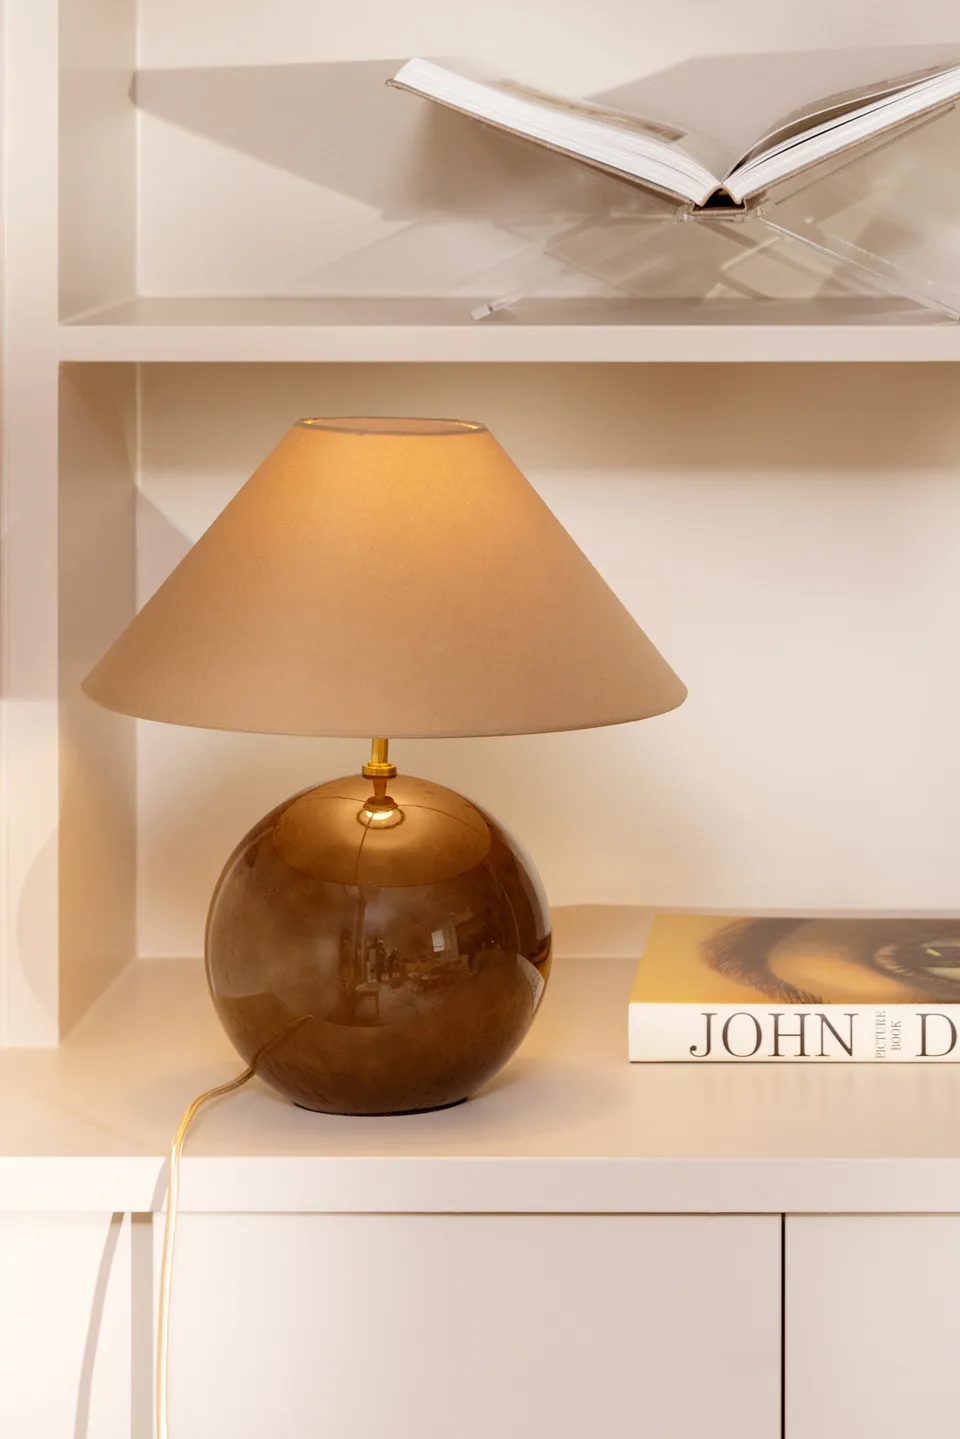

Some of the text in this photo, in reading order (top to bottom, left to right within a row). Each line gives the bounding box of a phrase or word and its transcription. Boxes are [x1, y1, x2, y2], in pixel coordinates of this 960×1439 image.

[690, 1012, 858, 1057] JOHN
[875, 1010, 886, 1058] PICTURE
[891, 1020, 902, 1051] BOOK
